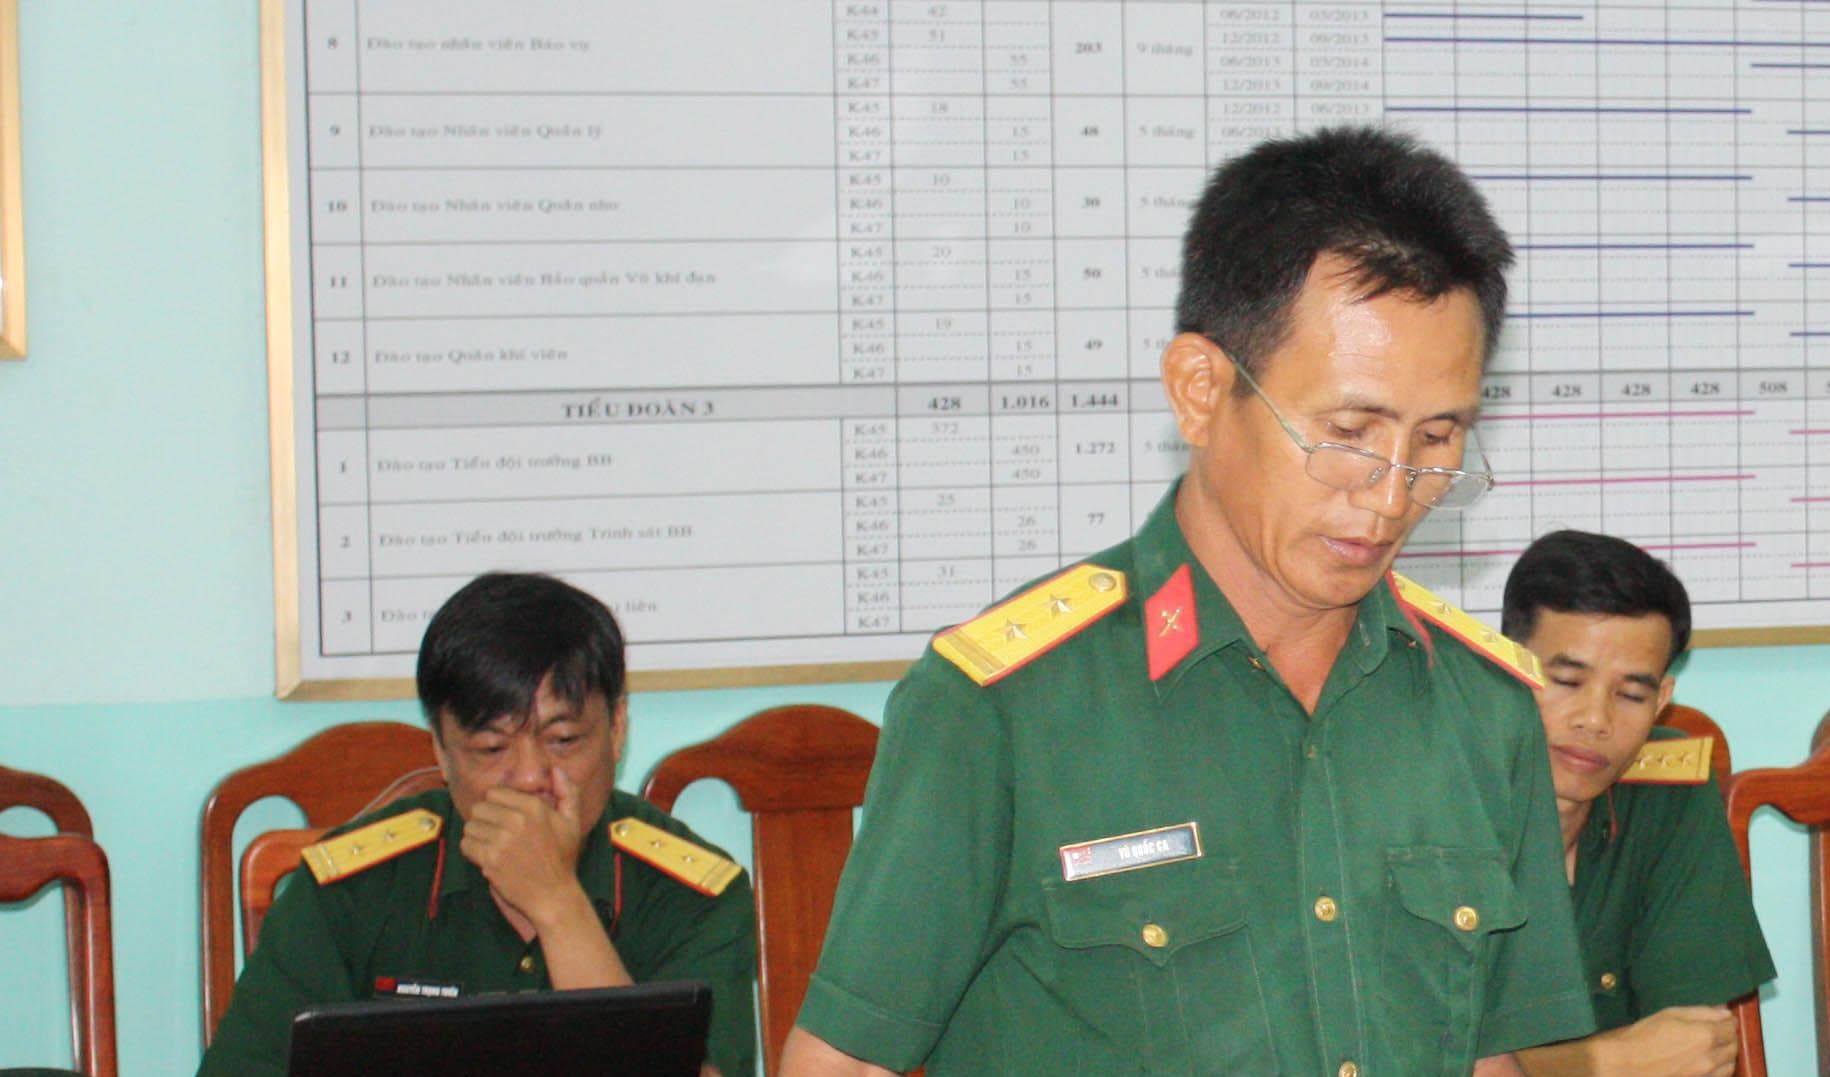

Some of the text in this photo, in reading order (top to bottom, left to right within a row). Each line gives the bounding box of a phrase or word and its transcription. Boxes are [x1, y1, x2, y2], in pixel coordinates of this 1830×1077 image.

[1482, 383, 1720, 399] 428 428 428 428
[1760, 382, 1787, 393] 508
[928, 397, 961, 410] 428
[1003, 396, 1049, 408] 1.016
[1072, 395, 1118, 406] 1.444
